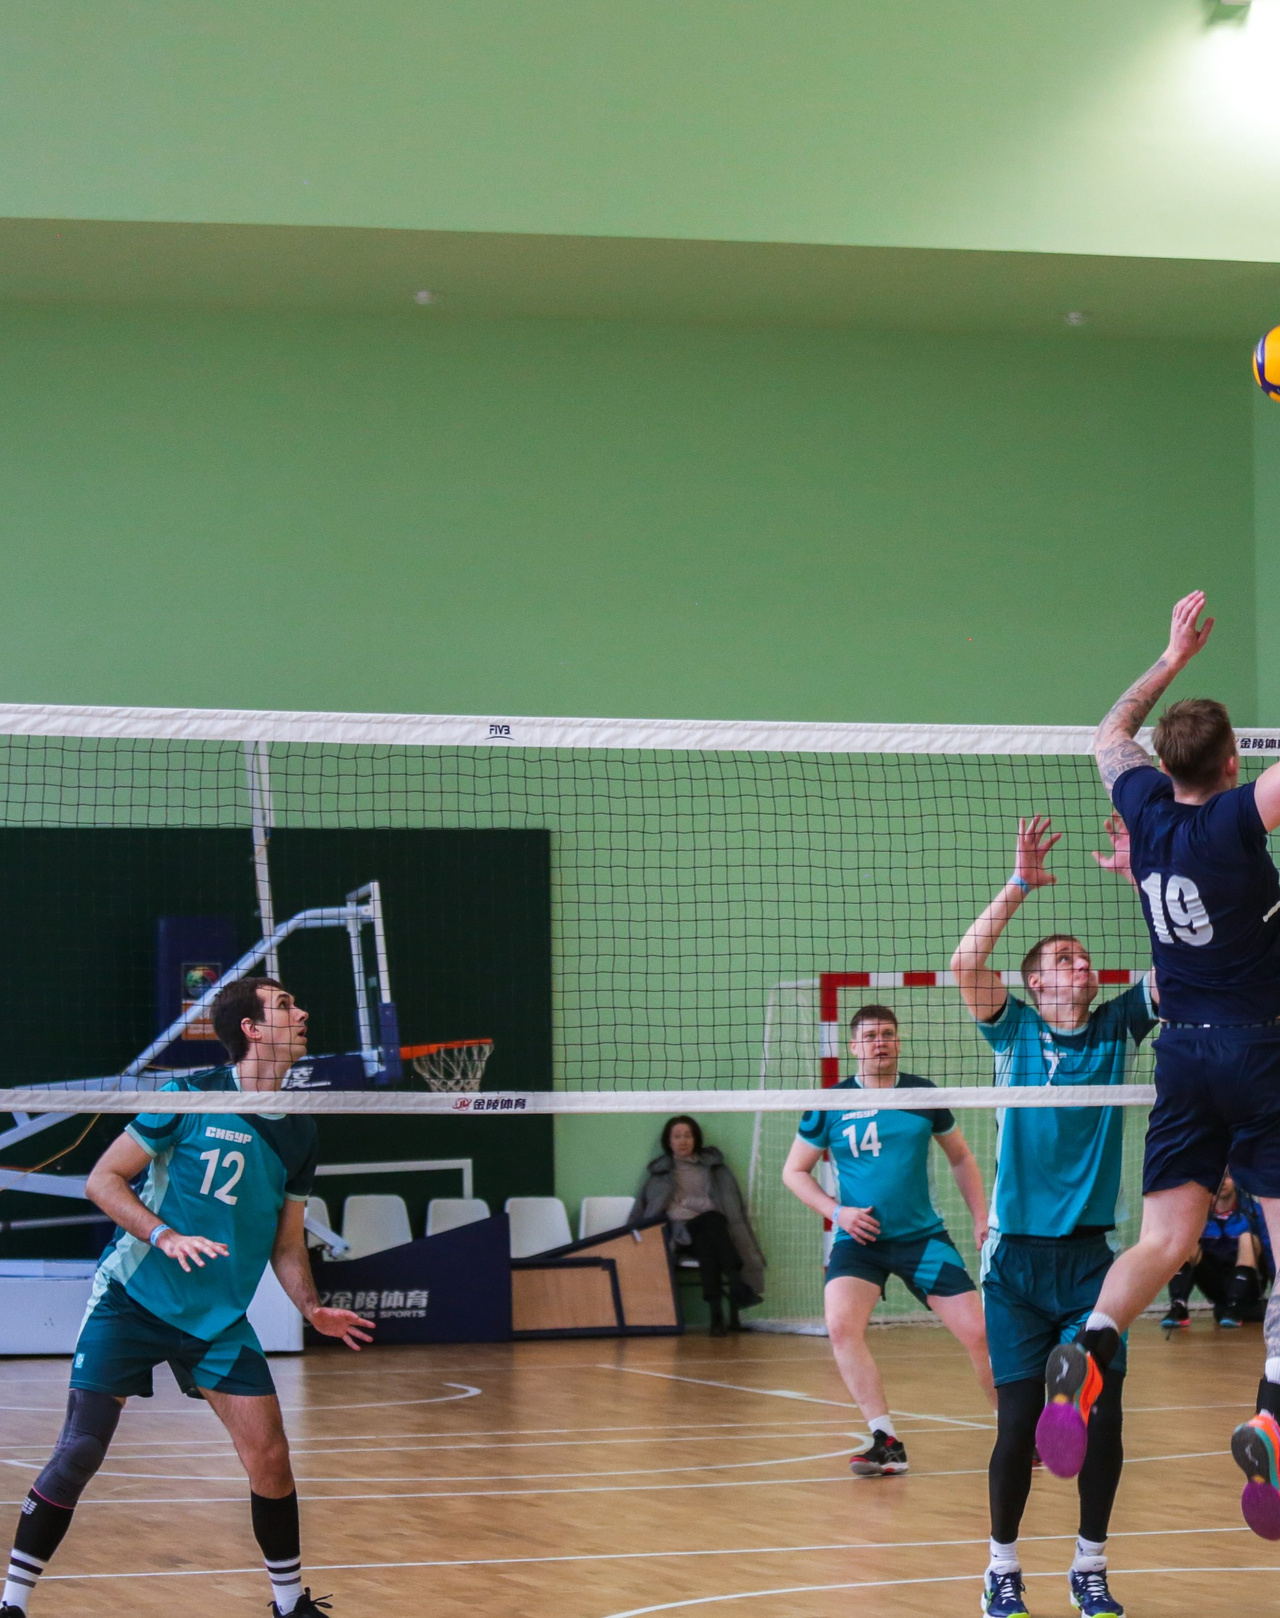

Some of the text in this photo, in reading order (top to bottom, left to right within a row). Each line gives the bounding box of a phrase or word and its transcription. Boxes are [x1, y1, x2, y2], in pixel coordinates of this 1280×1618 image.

[489, 724, 511, 735] FIVB
[1141, 872, 1213, 946] 19
[473, 1098, 526, 1110] 金陵体育
[205, 1126, 252, 1144] СИБУР
[842, 1121, 882, 1158] 14
[200, 1148, 245, 1206] 12
[380, 1309, 426, 1318] SPORTS
